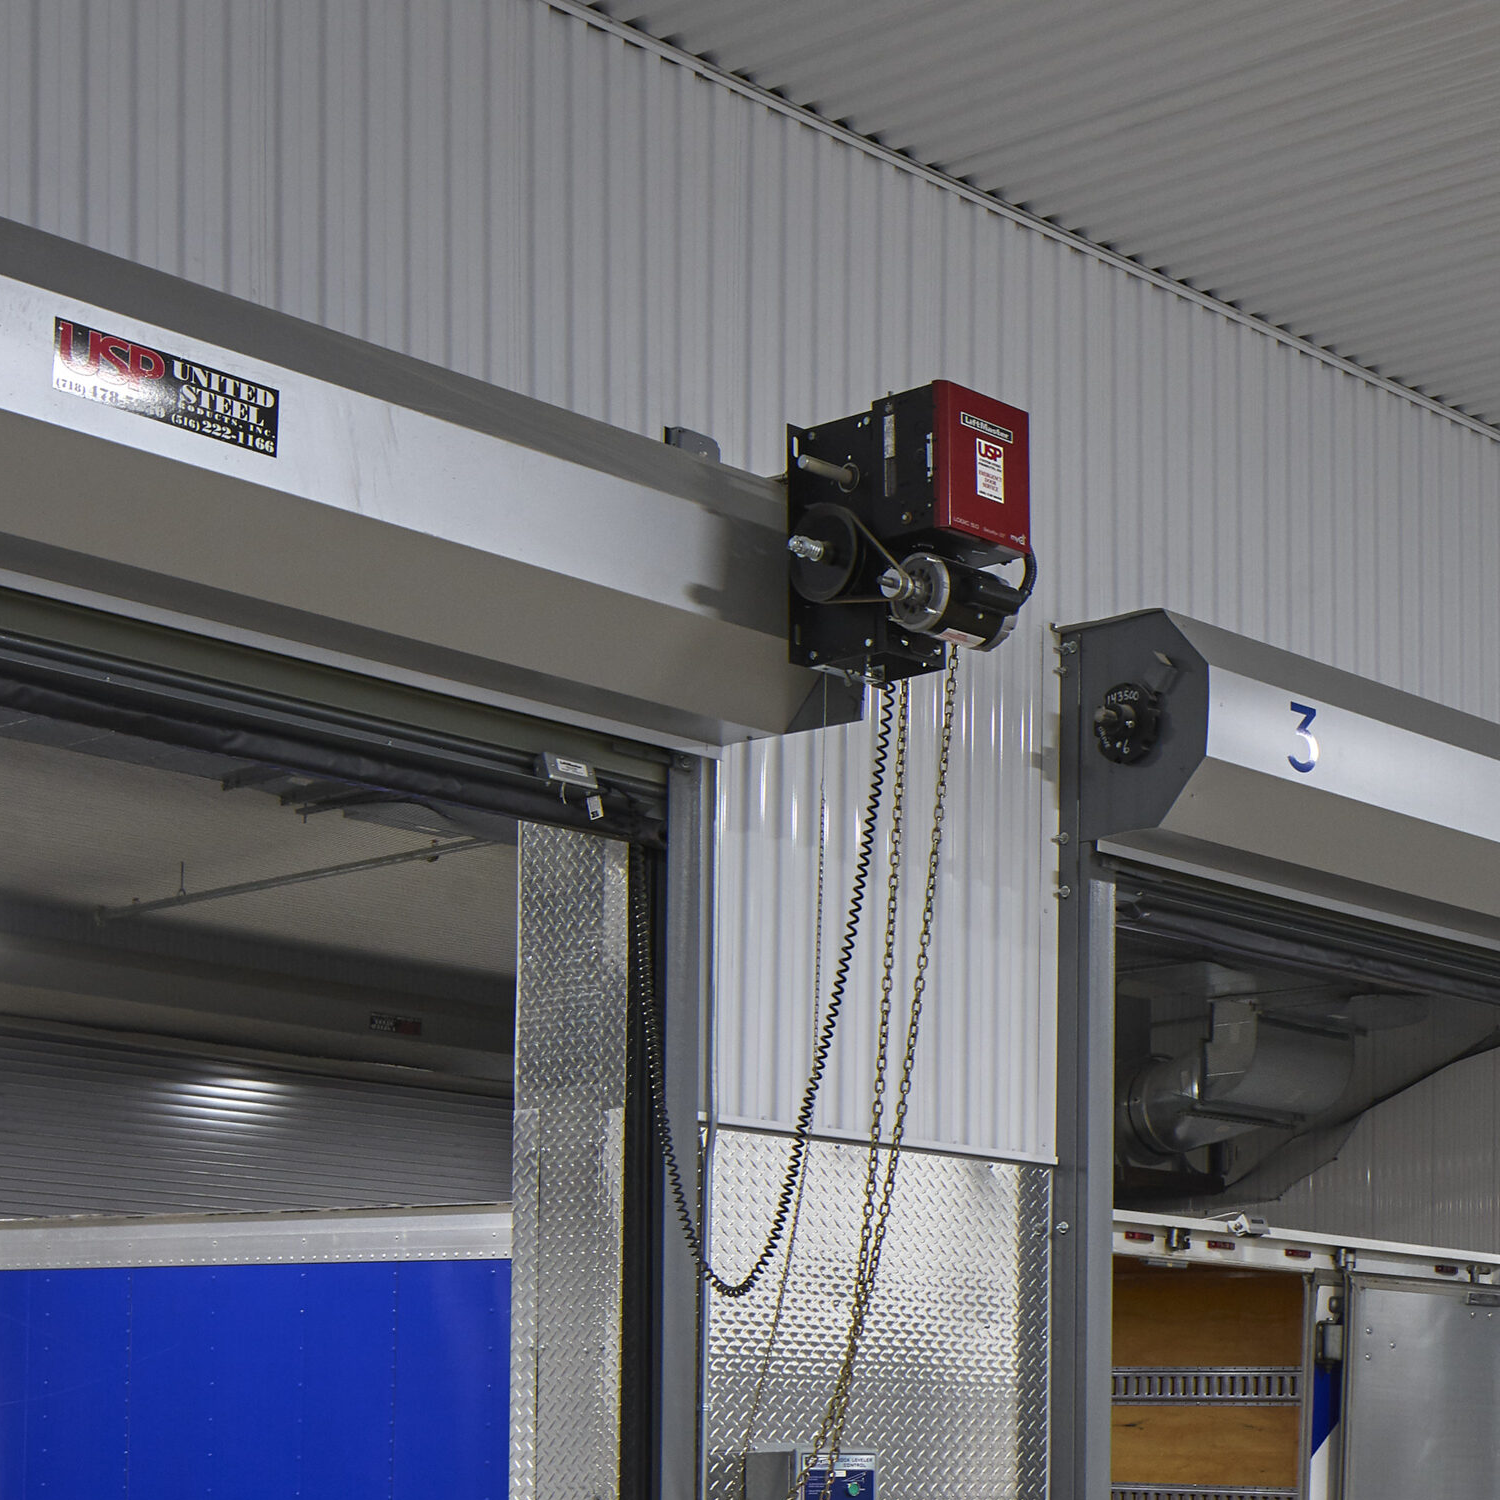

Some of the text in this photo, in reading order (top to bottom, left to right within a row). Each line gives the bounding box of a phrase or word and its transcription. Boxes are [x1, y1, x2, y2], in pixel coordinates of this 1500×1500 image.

[60, 321, 165, 392] USP
[56, 378, 86, 398] (718)
[173, 359, 275, 408] UNITED
[180, 384, 265, 427] STEEL
[171, 413, 275, 453] (516) 222-1166
[249, 424, 276, 439] INC.
[964, 415, 1010, 439] LiftMaster
[978, 440, 1003, 461] USP
[1287, 701, 1319, 773] 3
